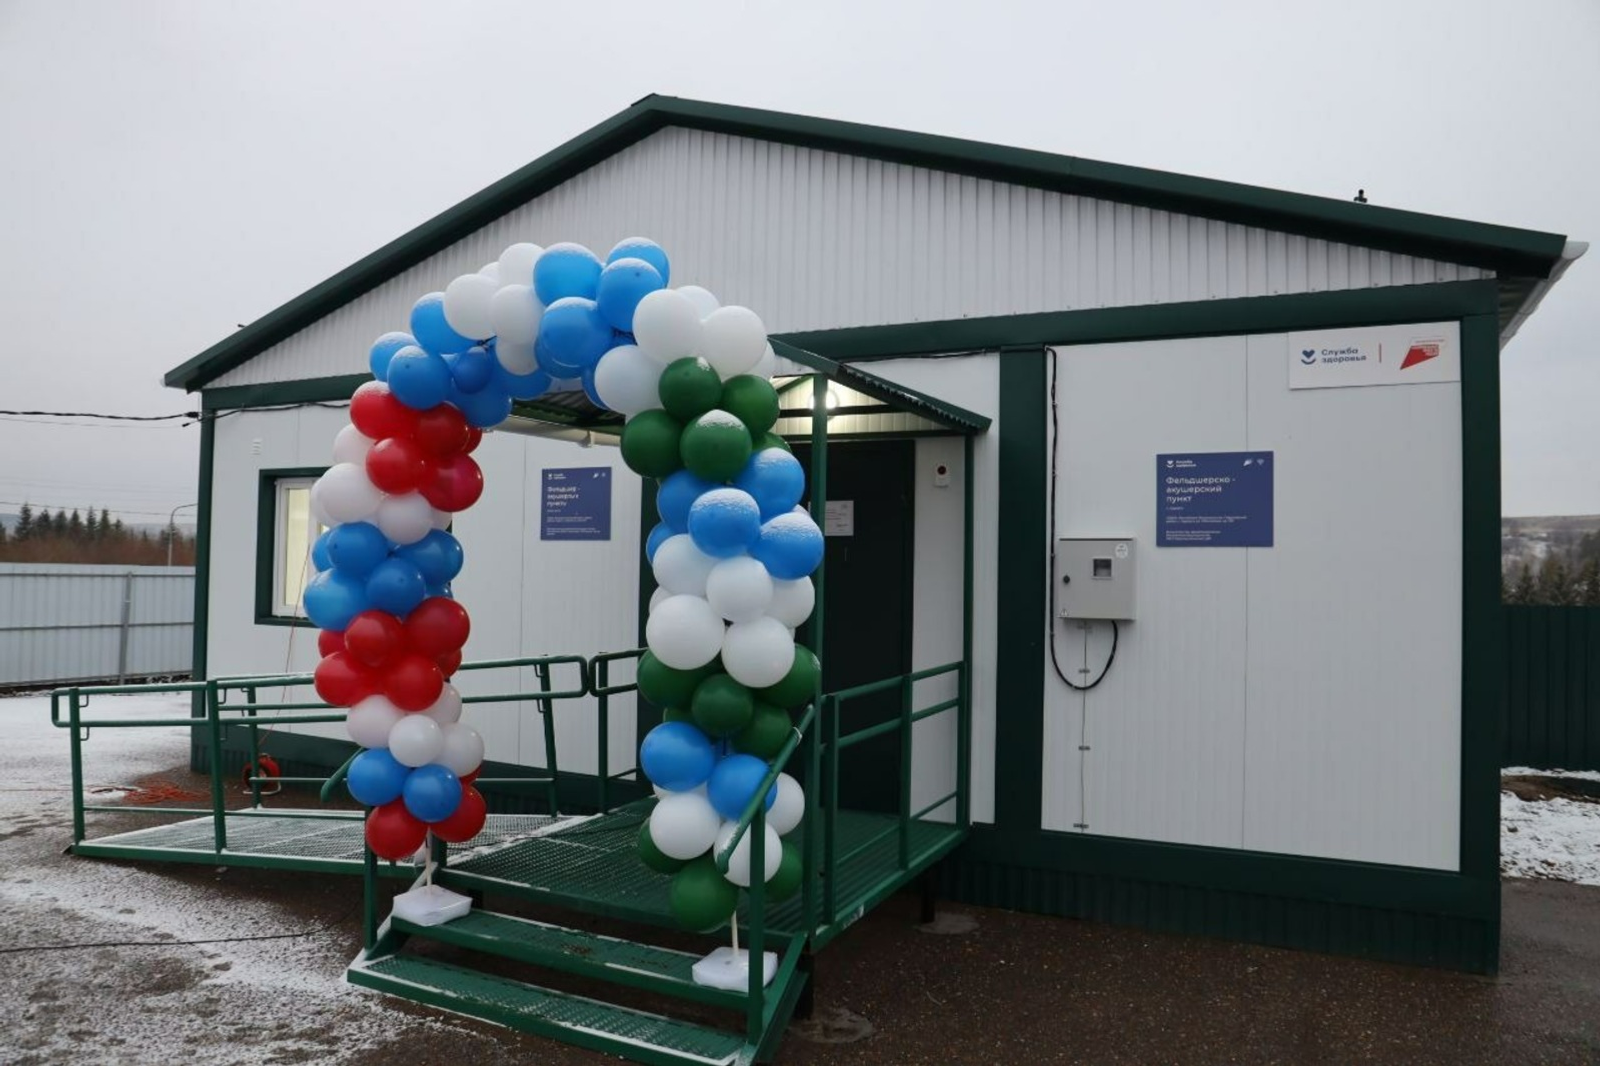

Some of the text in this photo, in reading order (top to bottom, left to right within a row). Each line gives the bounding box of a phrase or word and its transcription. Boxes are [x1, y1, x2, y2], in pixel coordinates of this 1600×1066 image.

[1321, 346, 1358, 357] Служба
[1321, 355, 1367, 364] здоровья
[1165, 476, 1231, 485] Фельдшерско
[1165, 485, 1222, 495] акушерский
[1166, 496, 1192, 505] пункт
